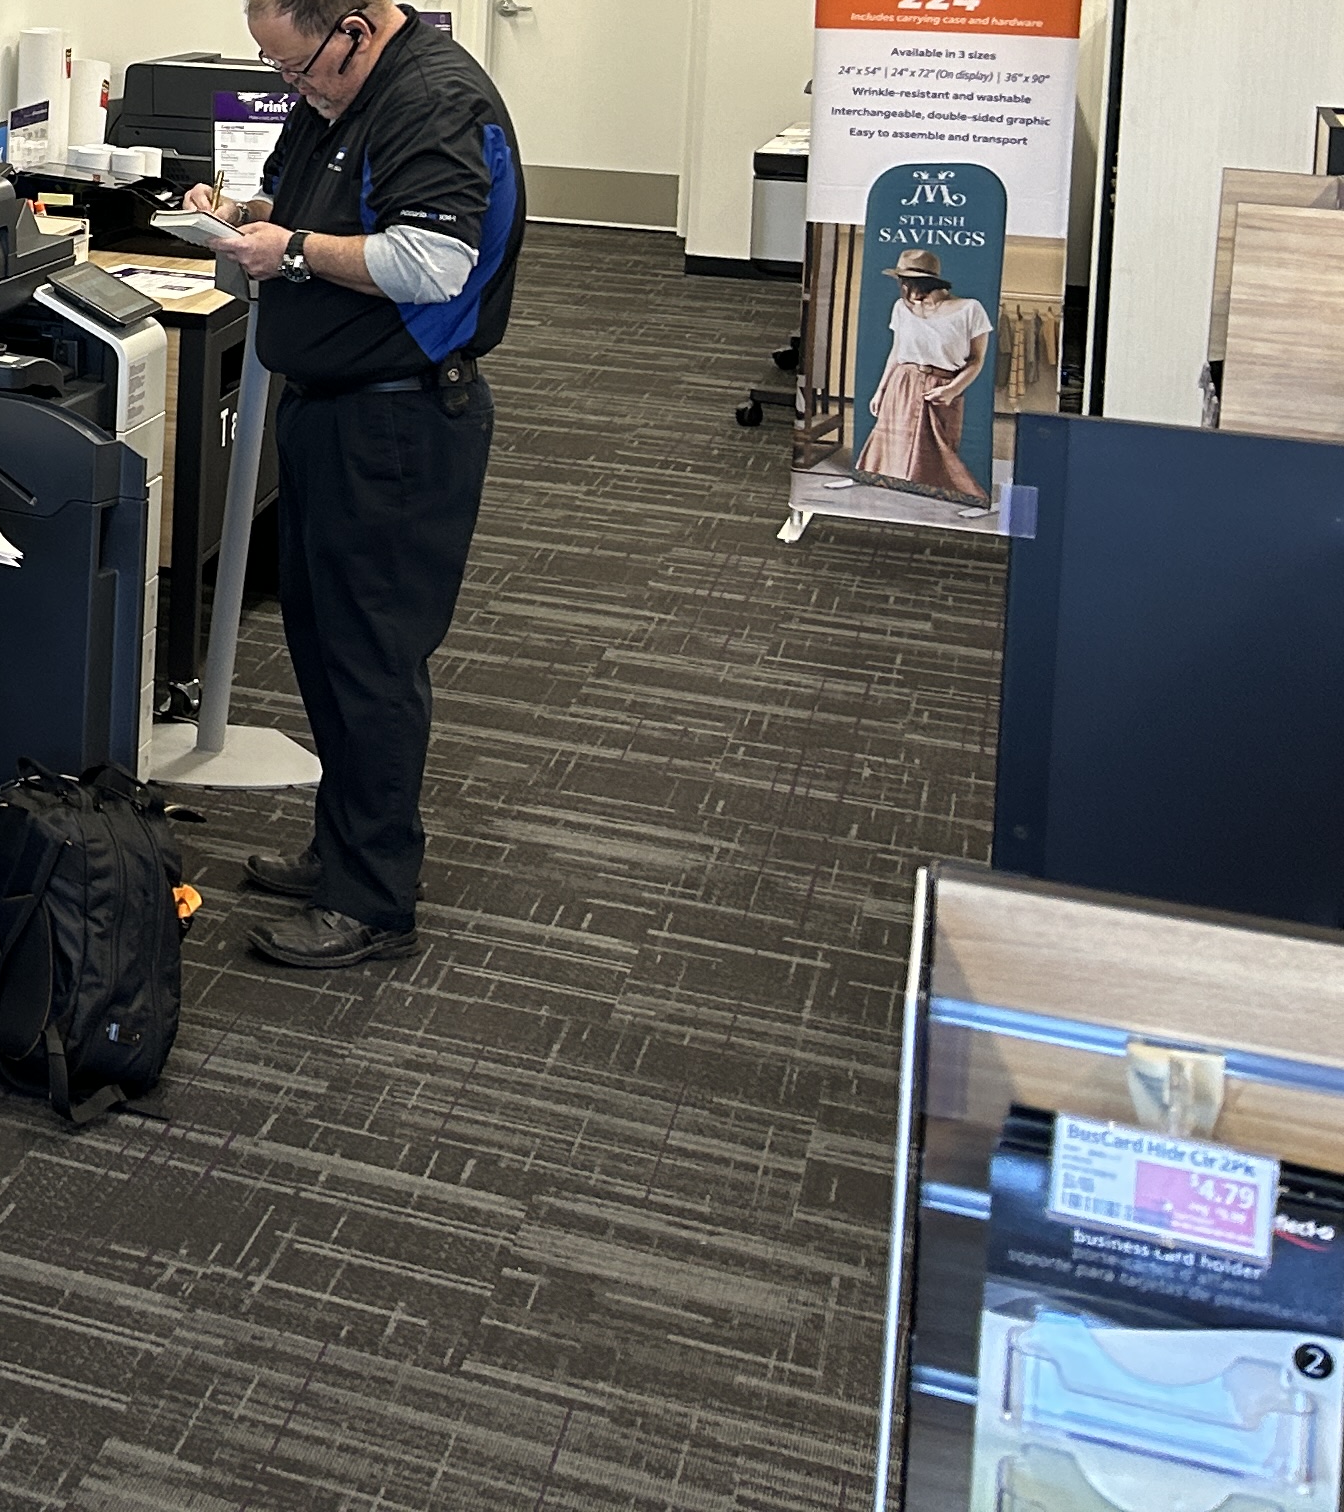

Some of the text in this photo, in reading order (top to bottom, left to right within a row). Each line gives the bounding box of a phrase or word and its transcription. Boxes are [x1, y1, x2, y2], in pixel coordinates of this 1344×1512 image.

[850, 12, 1043, 27] Includes carrying case and hardware
[891, 48, 943, 58] Available
[945, 49, 956, 59] in
[968, 51, 997, 60] sizes
[955, 70, 994, 83] display)
[852, 87, 1031, 104] Wrinkle-resistant and washable
[254, 100, 288, 113] Print
[831, 107, 1051, 126] Interchangeable, double-sided graphic
[850, 127, 1028, 146] Easy to assemble and transport
[899, 215, 965, 227] STYLISH
[879, 228, 985, 247] SAVINGS
[1190, 1173, 1255, 1209] $4.79
[1304, 1347, 1325, 1374] 2
